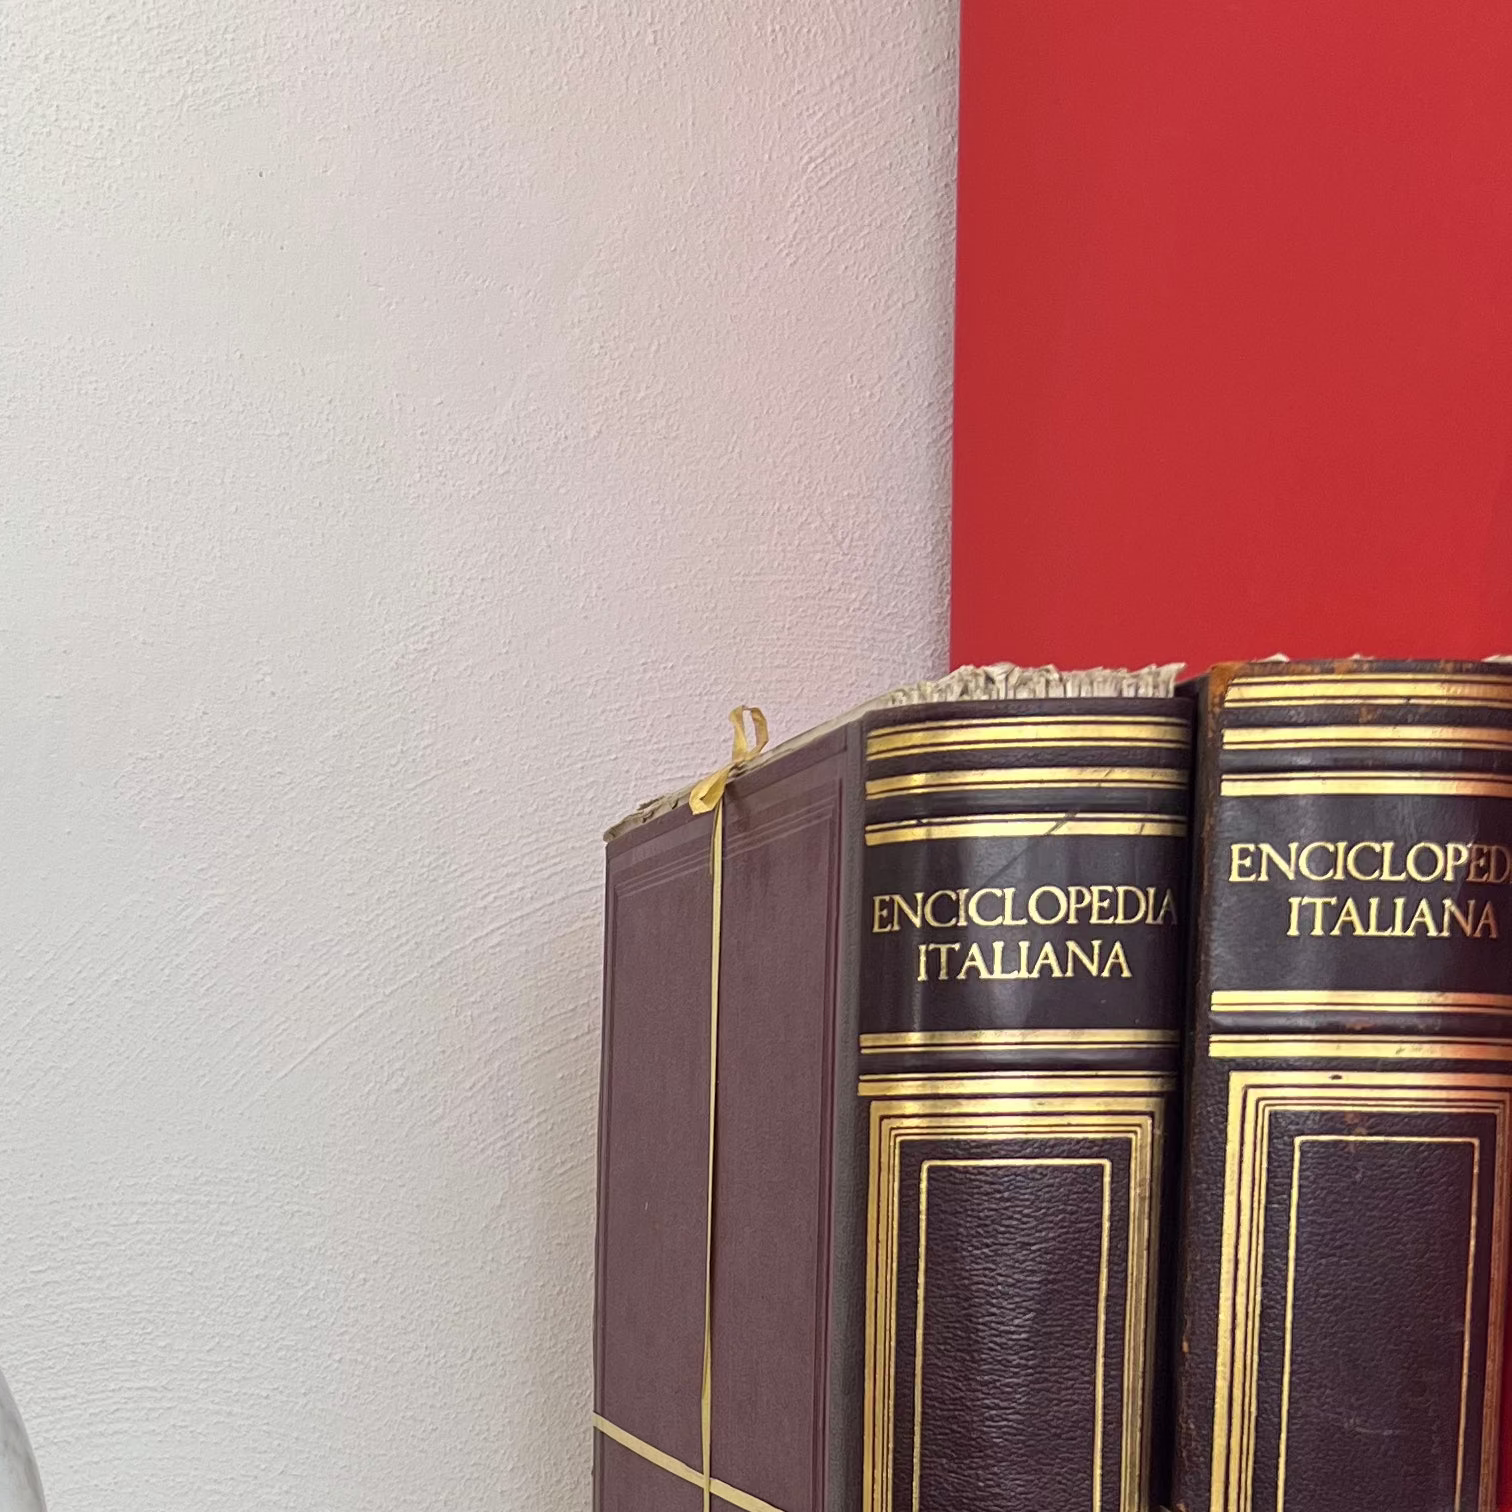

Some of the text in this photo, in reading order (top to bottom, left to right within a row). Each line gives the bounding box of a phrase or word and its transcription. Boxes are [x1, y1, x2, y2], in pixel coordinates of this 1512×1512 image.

[1229, 841, 1512, 882] ENCICLOPED
[872, 886, 1177, 933] ENCICLOPEDIA
[1287, 897, 1498, 938] ITALIANA
[917, 940, 1132, 981] ITALIANA
